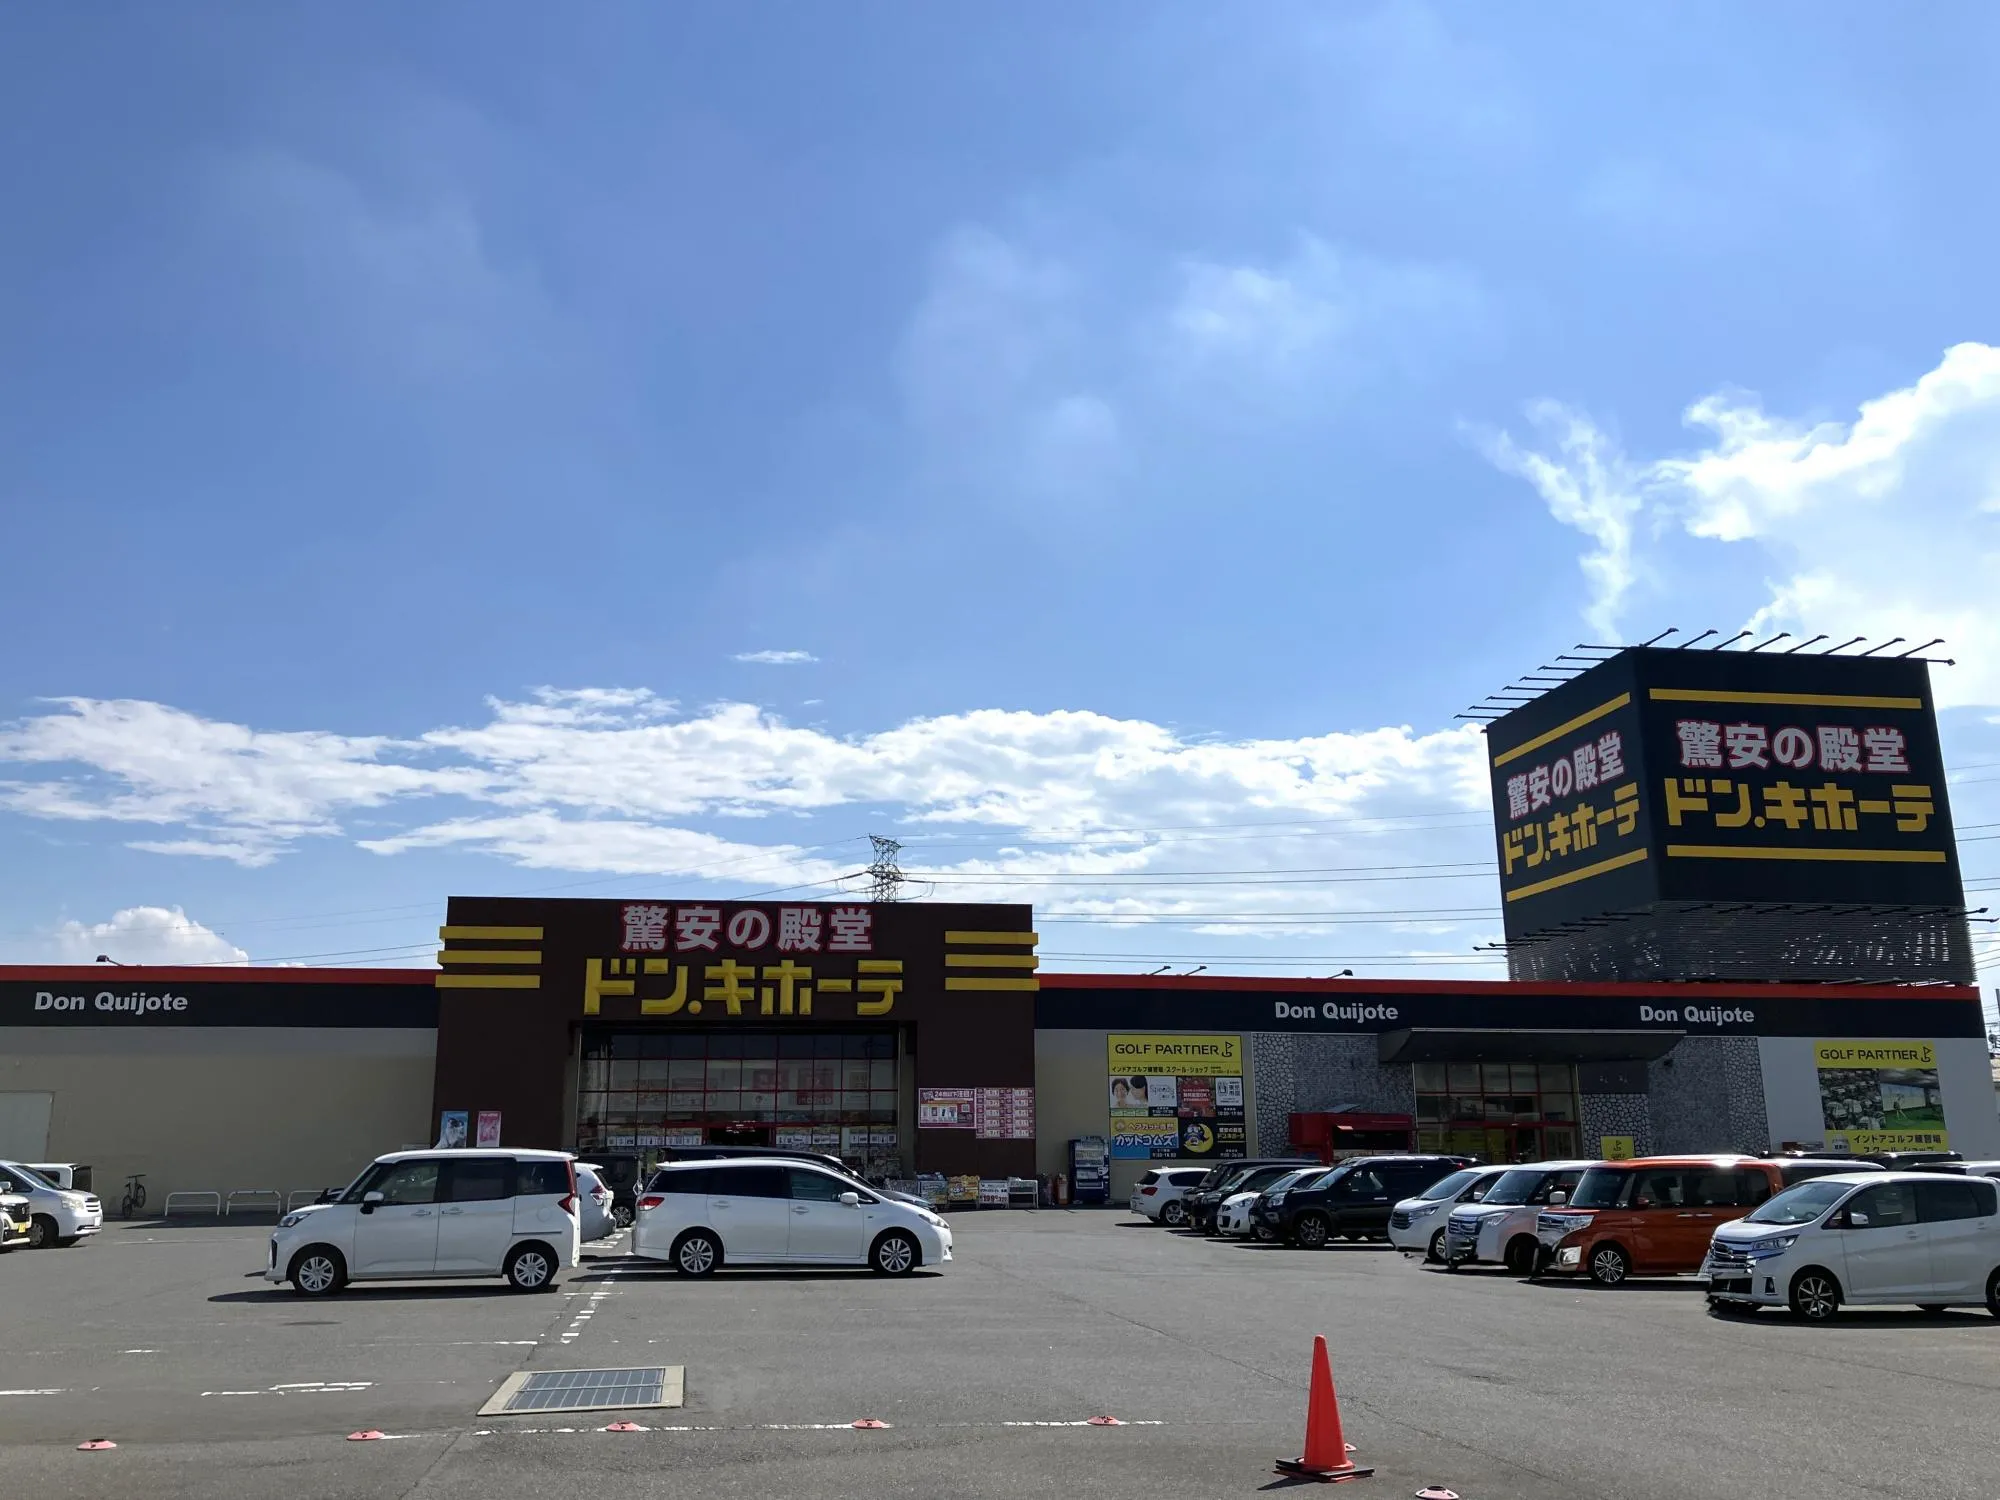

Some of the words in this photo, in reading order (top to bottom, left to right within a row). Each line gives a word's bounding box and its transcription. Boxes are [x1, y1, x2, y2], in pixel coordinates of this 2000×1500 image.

[1676, 719, 1910, 773] 驚安の殿堂
[1507, 730, 1625, 819] 驚安の殿堂
[621, 903, 874, 953] 驚安の殿堂
[34, 992, 86, 1011] Don
[94, 992, 189, 1015] Quijote
[1274, 1001, 1316, 1019] Don
[1322, 1002, 1399, 1024] Quijote
[1639, 1005, 1679, 1022] Don
[1684, 1005, 1755, 1026] Quijote
[1115, 1044, 1151, 1054] GOLF
[1155, 1044, 1220, 1055] PARTNER
[1820, 1049, 1854, 1060] GOLF
[1858, 1049, 1918, 1060] PARTNER
[1115, 1134, 1175, 1146] カットコムズ
